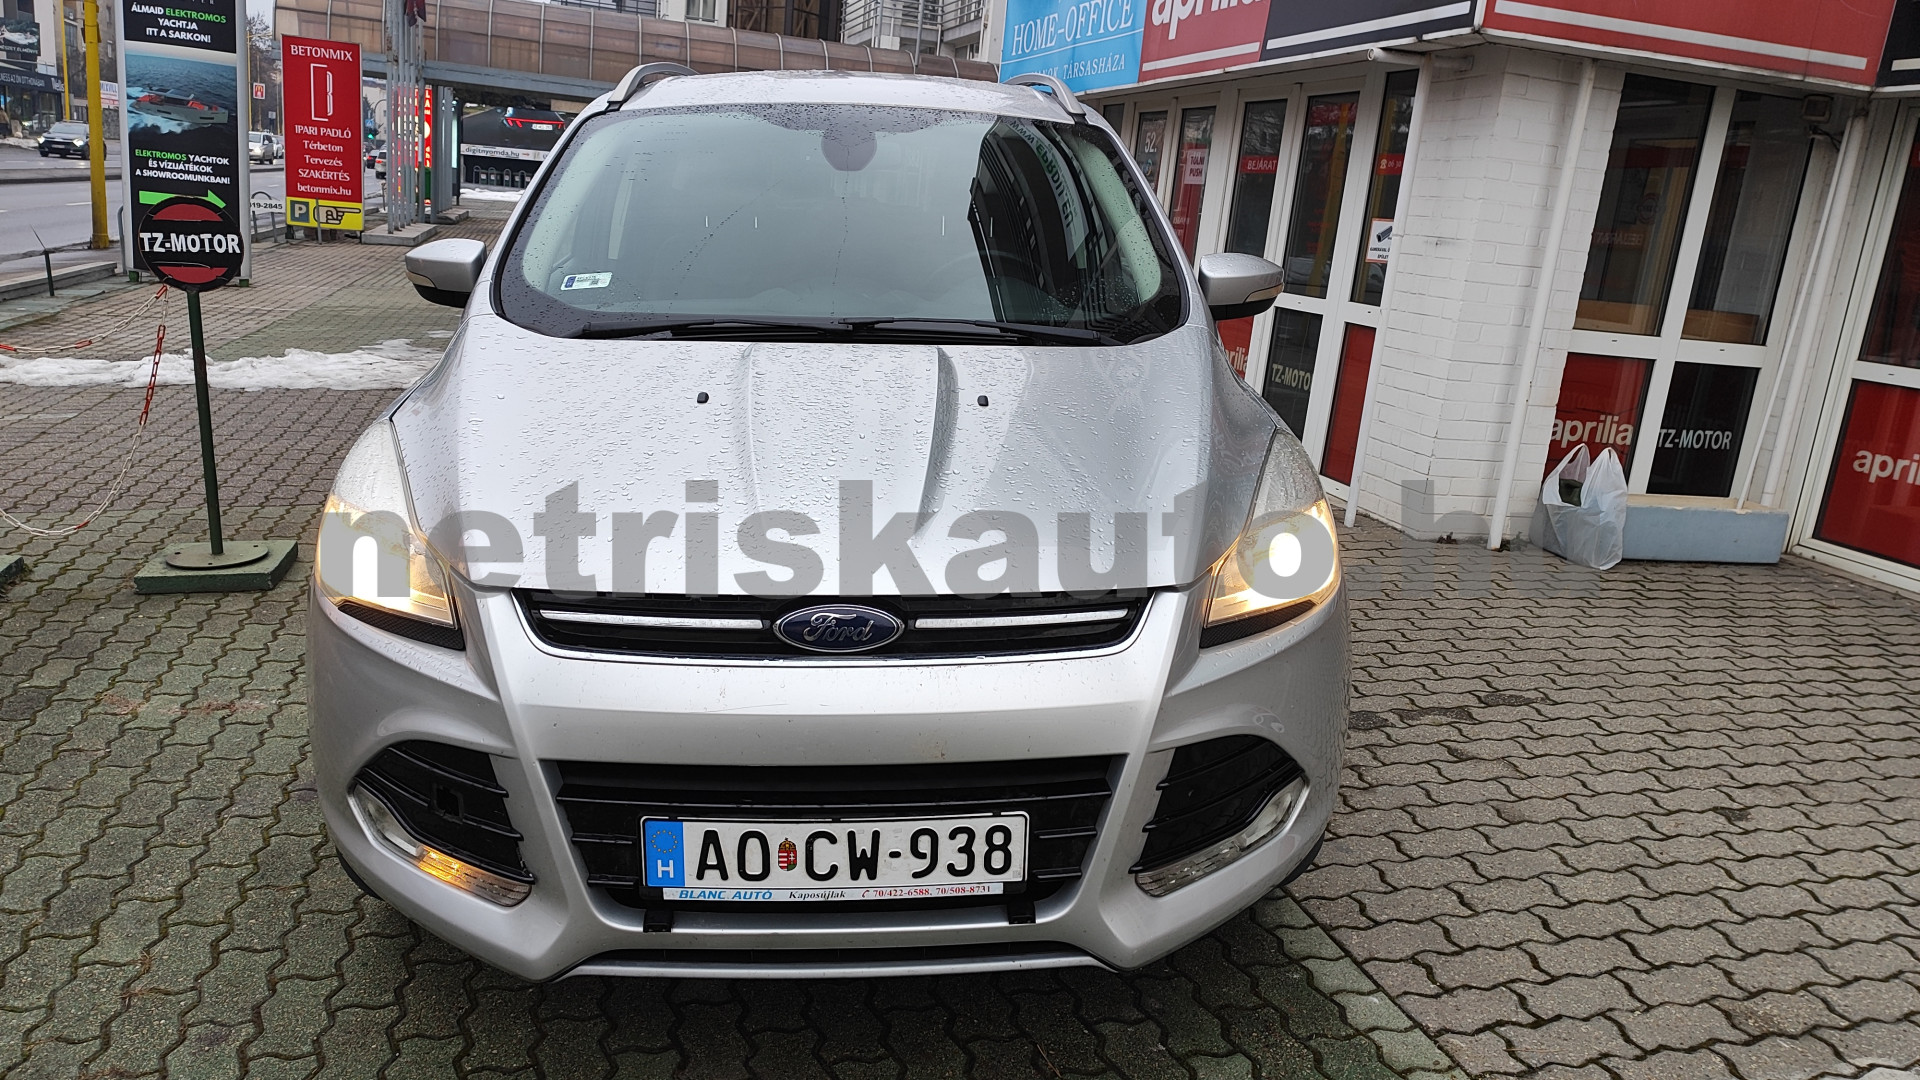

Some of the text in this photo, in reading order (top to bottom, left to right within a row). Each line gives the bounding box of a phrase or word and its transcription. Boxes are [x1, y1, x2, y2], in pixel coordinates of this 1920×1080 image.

[131, 3, 227, 24] ÁLMAID ELEKTROMOS
[157, 18, 198, 31] YACHTJA
[1011, 0, 1134, 56] HOME-OFFICE
[146, 28, 211, 43] ITT A SARKON!
[290, 44, 353, 62] BETONMIX
[1063, 52, 1125, 80] TÁRSASHÁZA
[295, 124, 352, 139] IPARI PADLÓ
[303, 140, 343, 153] Térbeton
[1144, 132, 1157, 153] 52.
[135, 149, 230, 166] ELEKTROMOS YACHTOK
[148, 159, 213, 173] ÉS VÍZIJÁTÉKOK
[304, 155, 343, 167] Tervezés
[1247, 159, 1277, 170] BEJÁRAT
[142, 169, 231, 184] SHOWROOMUNKBAN!
[298, 168, 350, 182] SZAKÉRTÉS
[1189, 168, 1203, 177] PUSH
[297, 183, 352, 196] betonmix.hu
[294, 203, 306, 218] P
[139, 232, 241, 254] TZ-MOTOR
[1550, 414, 1634, 449] aprilia
[1657, 428, 1733, 450] TZ-MOTOR
[803, 612, 875, 641] Ford
[695, 824, 1013, 882] AO CW-938
[656, 859, 675, 879] H
[678, 889, 727, 900] BLANC
[731, 889, 773, 900] AUTÓ
[788, 888, 847, 901] Kaposújlak
[935, 884, 992, 896] 70/508-8731
